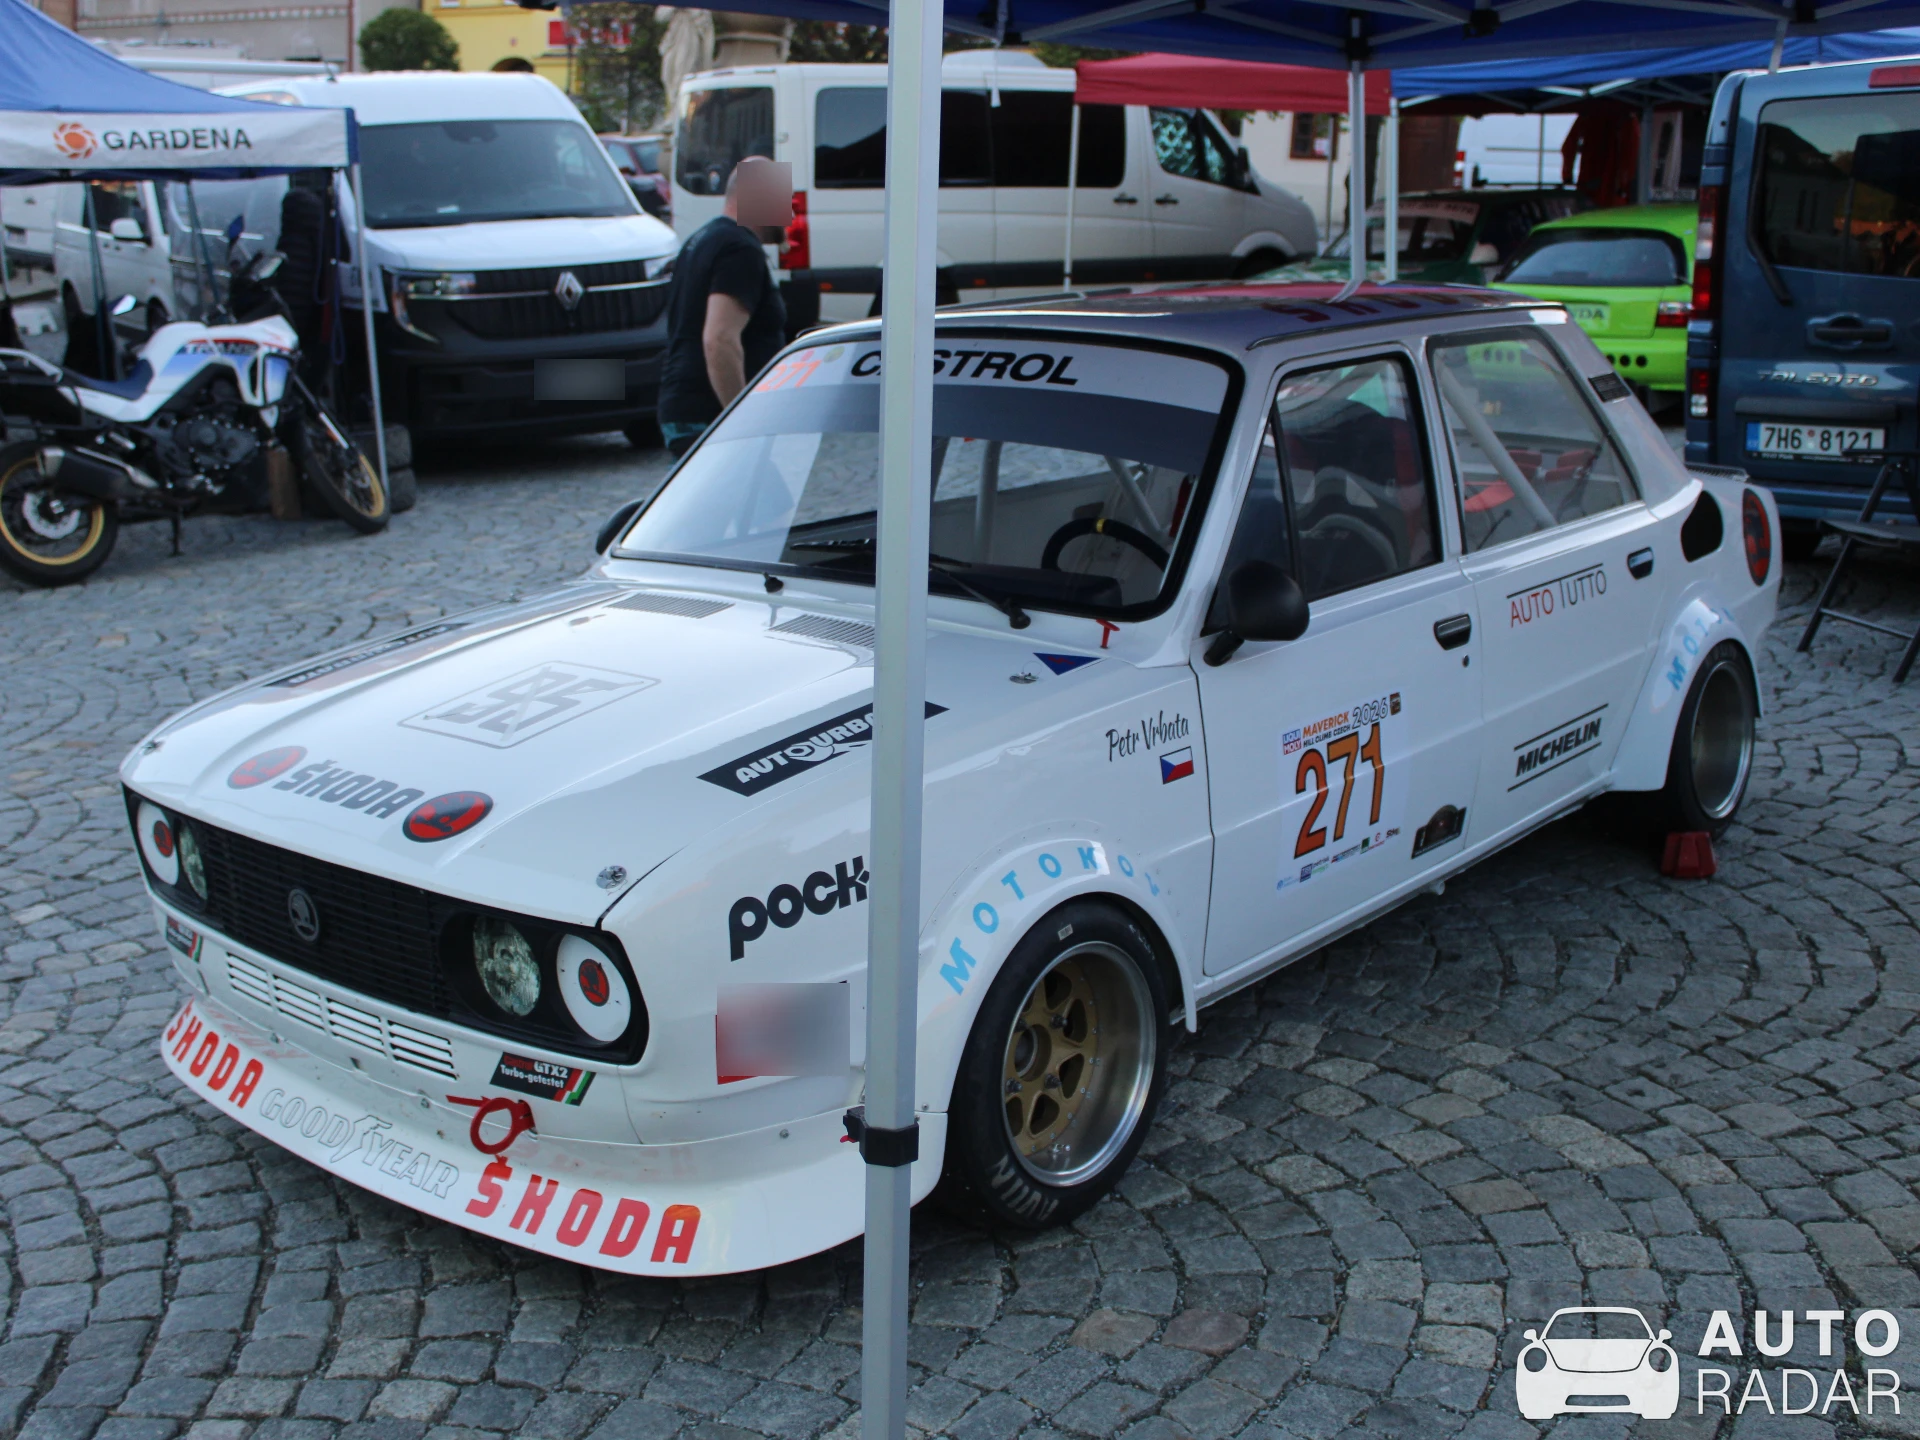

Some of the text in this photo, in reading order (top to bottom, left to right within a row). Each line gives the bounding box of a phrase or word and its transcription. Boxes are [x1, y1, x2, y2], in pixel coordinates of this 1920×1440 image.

[103, 128, 253, 150] GARDENA
[851, 350, 1078, 386] CSTROL
[1764, 427, 1873, 451] 7H6 8121
[1510, 570, 1607, 629] AUTO TUTTO
[1303, 711, 1349, 739] MAVERICK
[1352, 697, 1388, 730] 2026
[1105, 710, 1189, 762] Petr Vrbata
[1284, 740, 1302, 754] MOLY
[1303, 740, 1314, 749] HILL
[1333, 724, 1350, 737] CZECH
[1515, 718, 1602, 777] MICHELIN
[271, 759, 425, 819] ŠKODA
[1294, 721, 1385, 860] 271
[500, 1064, 565, 1089] Turbo-getestet
[534, 1061, 568, 1079] GTX2
[465, 1155, 702, 1264] ŠKODA
